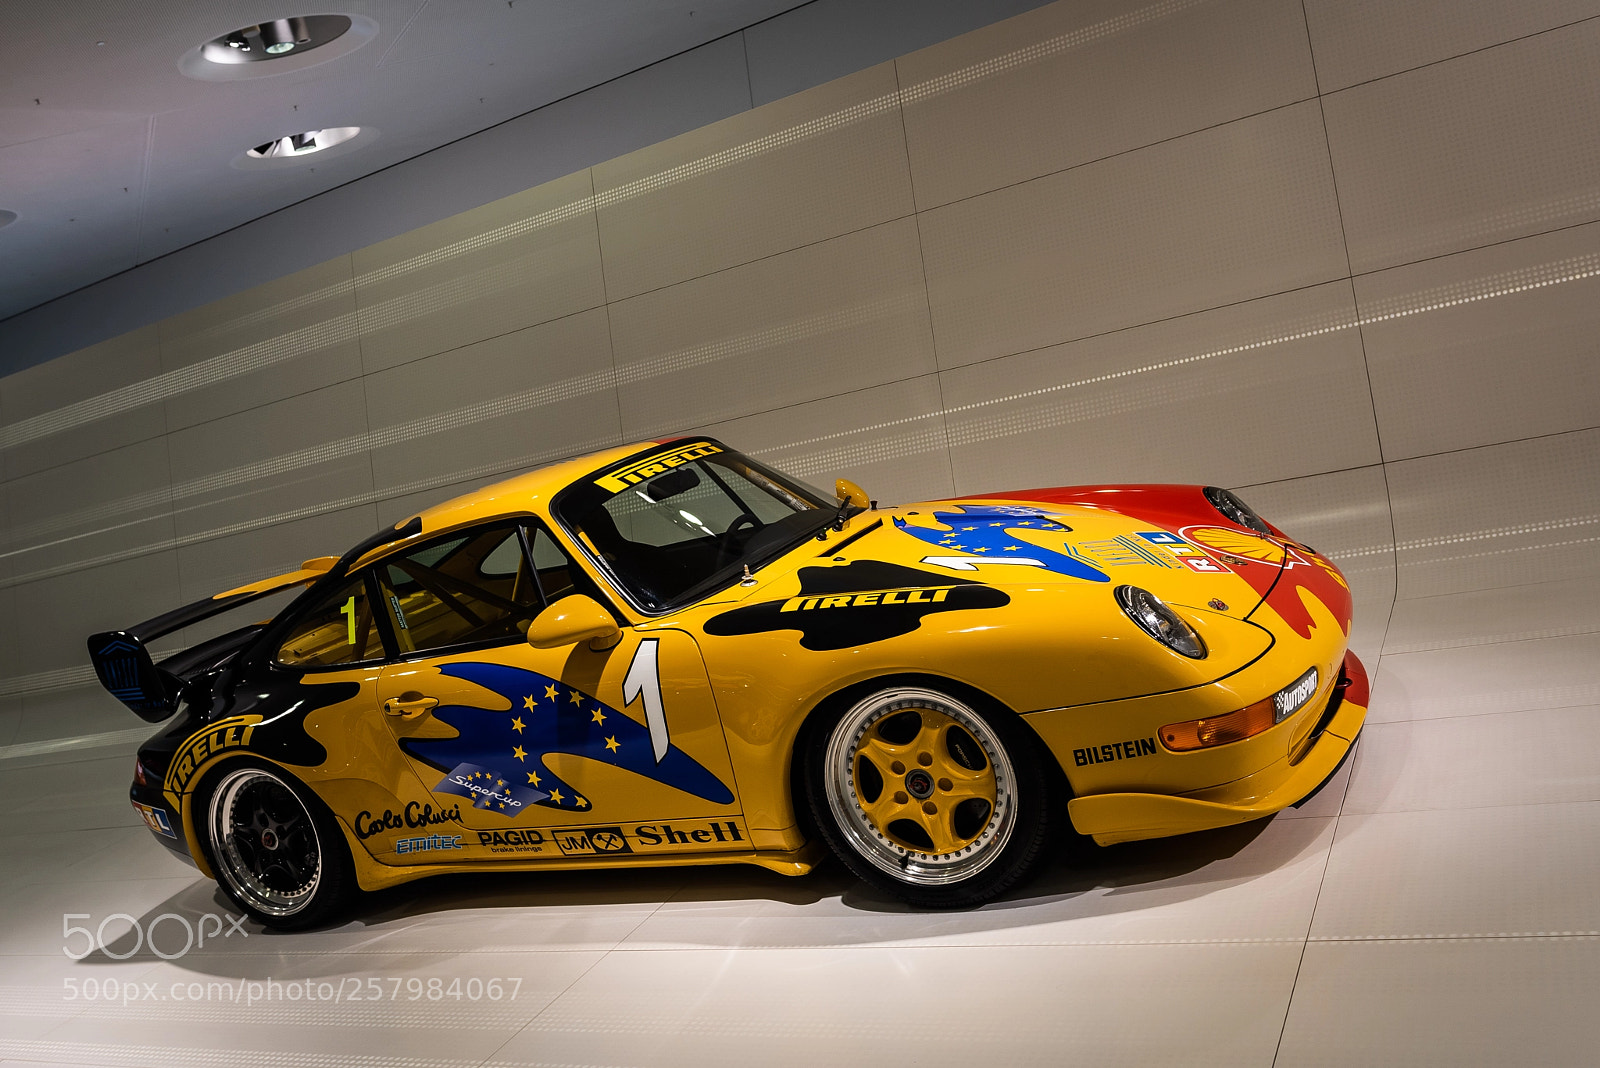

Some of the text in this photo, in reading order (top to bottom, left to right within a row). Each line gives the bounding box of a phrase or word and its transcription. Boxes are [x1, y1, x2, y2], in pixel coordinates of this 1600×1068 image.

[593, 442, 724, 494] PIRELLI
[780, 589, 950, 613] PIRELLI
[340, 596, 356, 645] 1
[622, 637, 670, 766] 1
[163, 714, 264, 815] PIRELLI
[954, 743, 974, 770] PORSCH
[1073, 738, 1157, 766] BILSTEIN
[448, 775, 522, 807] Supercup
[477, 830, 545, 846] PAGID
[634, 821, 746, 846] Shell
